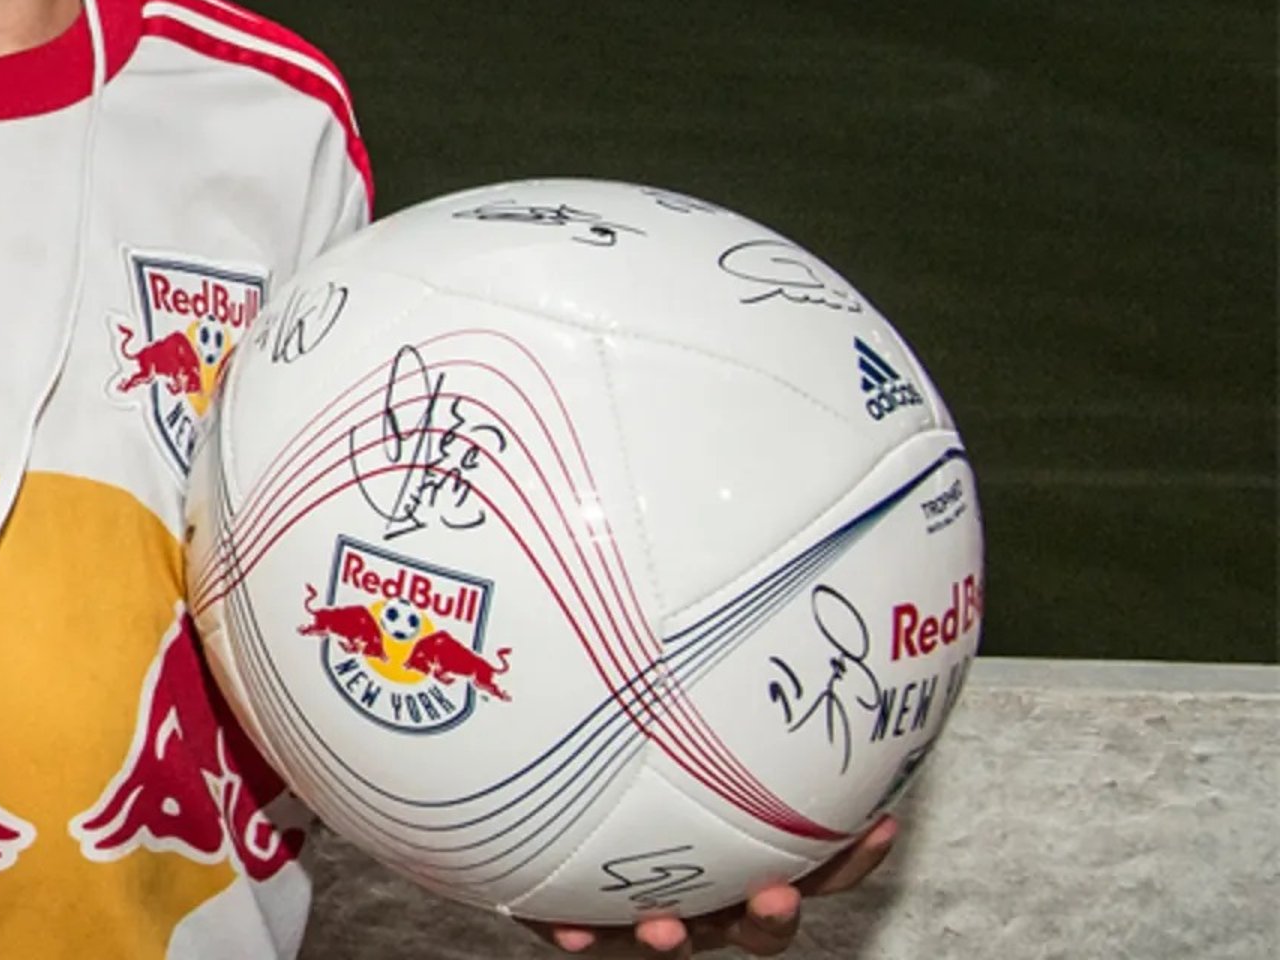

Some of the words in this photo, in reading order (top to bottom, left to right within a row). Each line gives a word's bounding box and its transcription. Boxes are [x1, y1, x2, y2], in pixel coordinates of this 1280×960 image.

[148, 271, 210, 319] Red
[212, 283, 259, 331] Bull
[341, 551, 406, 600] Red
[408, 573, 479, 624] Bull
[890, 581, 960, 662] Red
[334, 657, 382, 709] NEW
[390, 685, 458, 725] YORK
[869, 671, 939, 743] NEW
